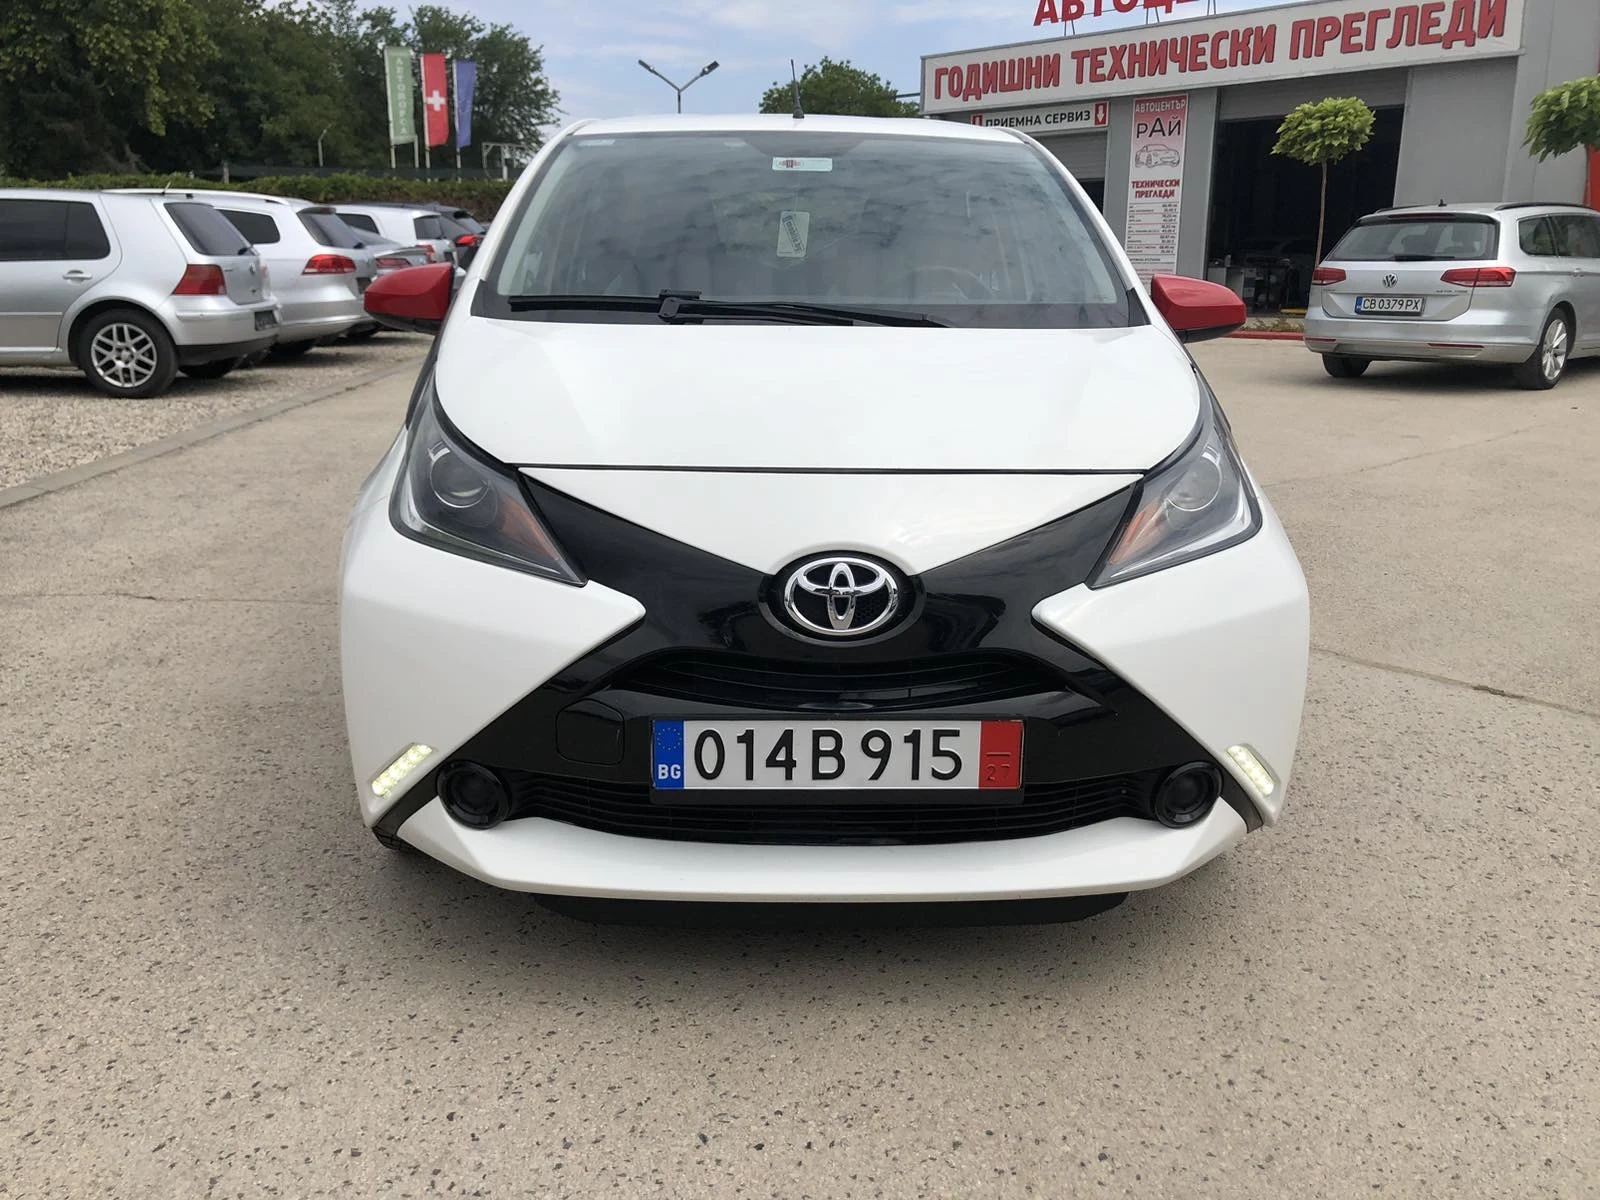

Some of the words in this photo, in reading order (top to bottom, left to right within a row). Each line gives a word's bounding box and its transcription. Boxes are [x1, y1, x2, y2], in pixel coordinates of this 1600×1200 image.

[934, 53, 1061, 101] ГОДИШНИ
[1071, 24, 1277, 85] ТЕХНИЧЕСКИ
[1289, 0, 1507, 60] ПРЕГЛЕДИ
[985, 115, 1041, 127] ПРИЕМНА
[1044, 110, 1091, 124] СЕРВИЗ
[1131, 178, 1180, 189] ТЕХНИЧЕСКИ
[1135, 189, 1175, 199] ПРЕГЛЕДИ
[1378, 299, 1405, 310] 0379
[657, 764, 681, 780] BG
